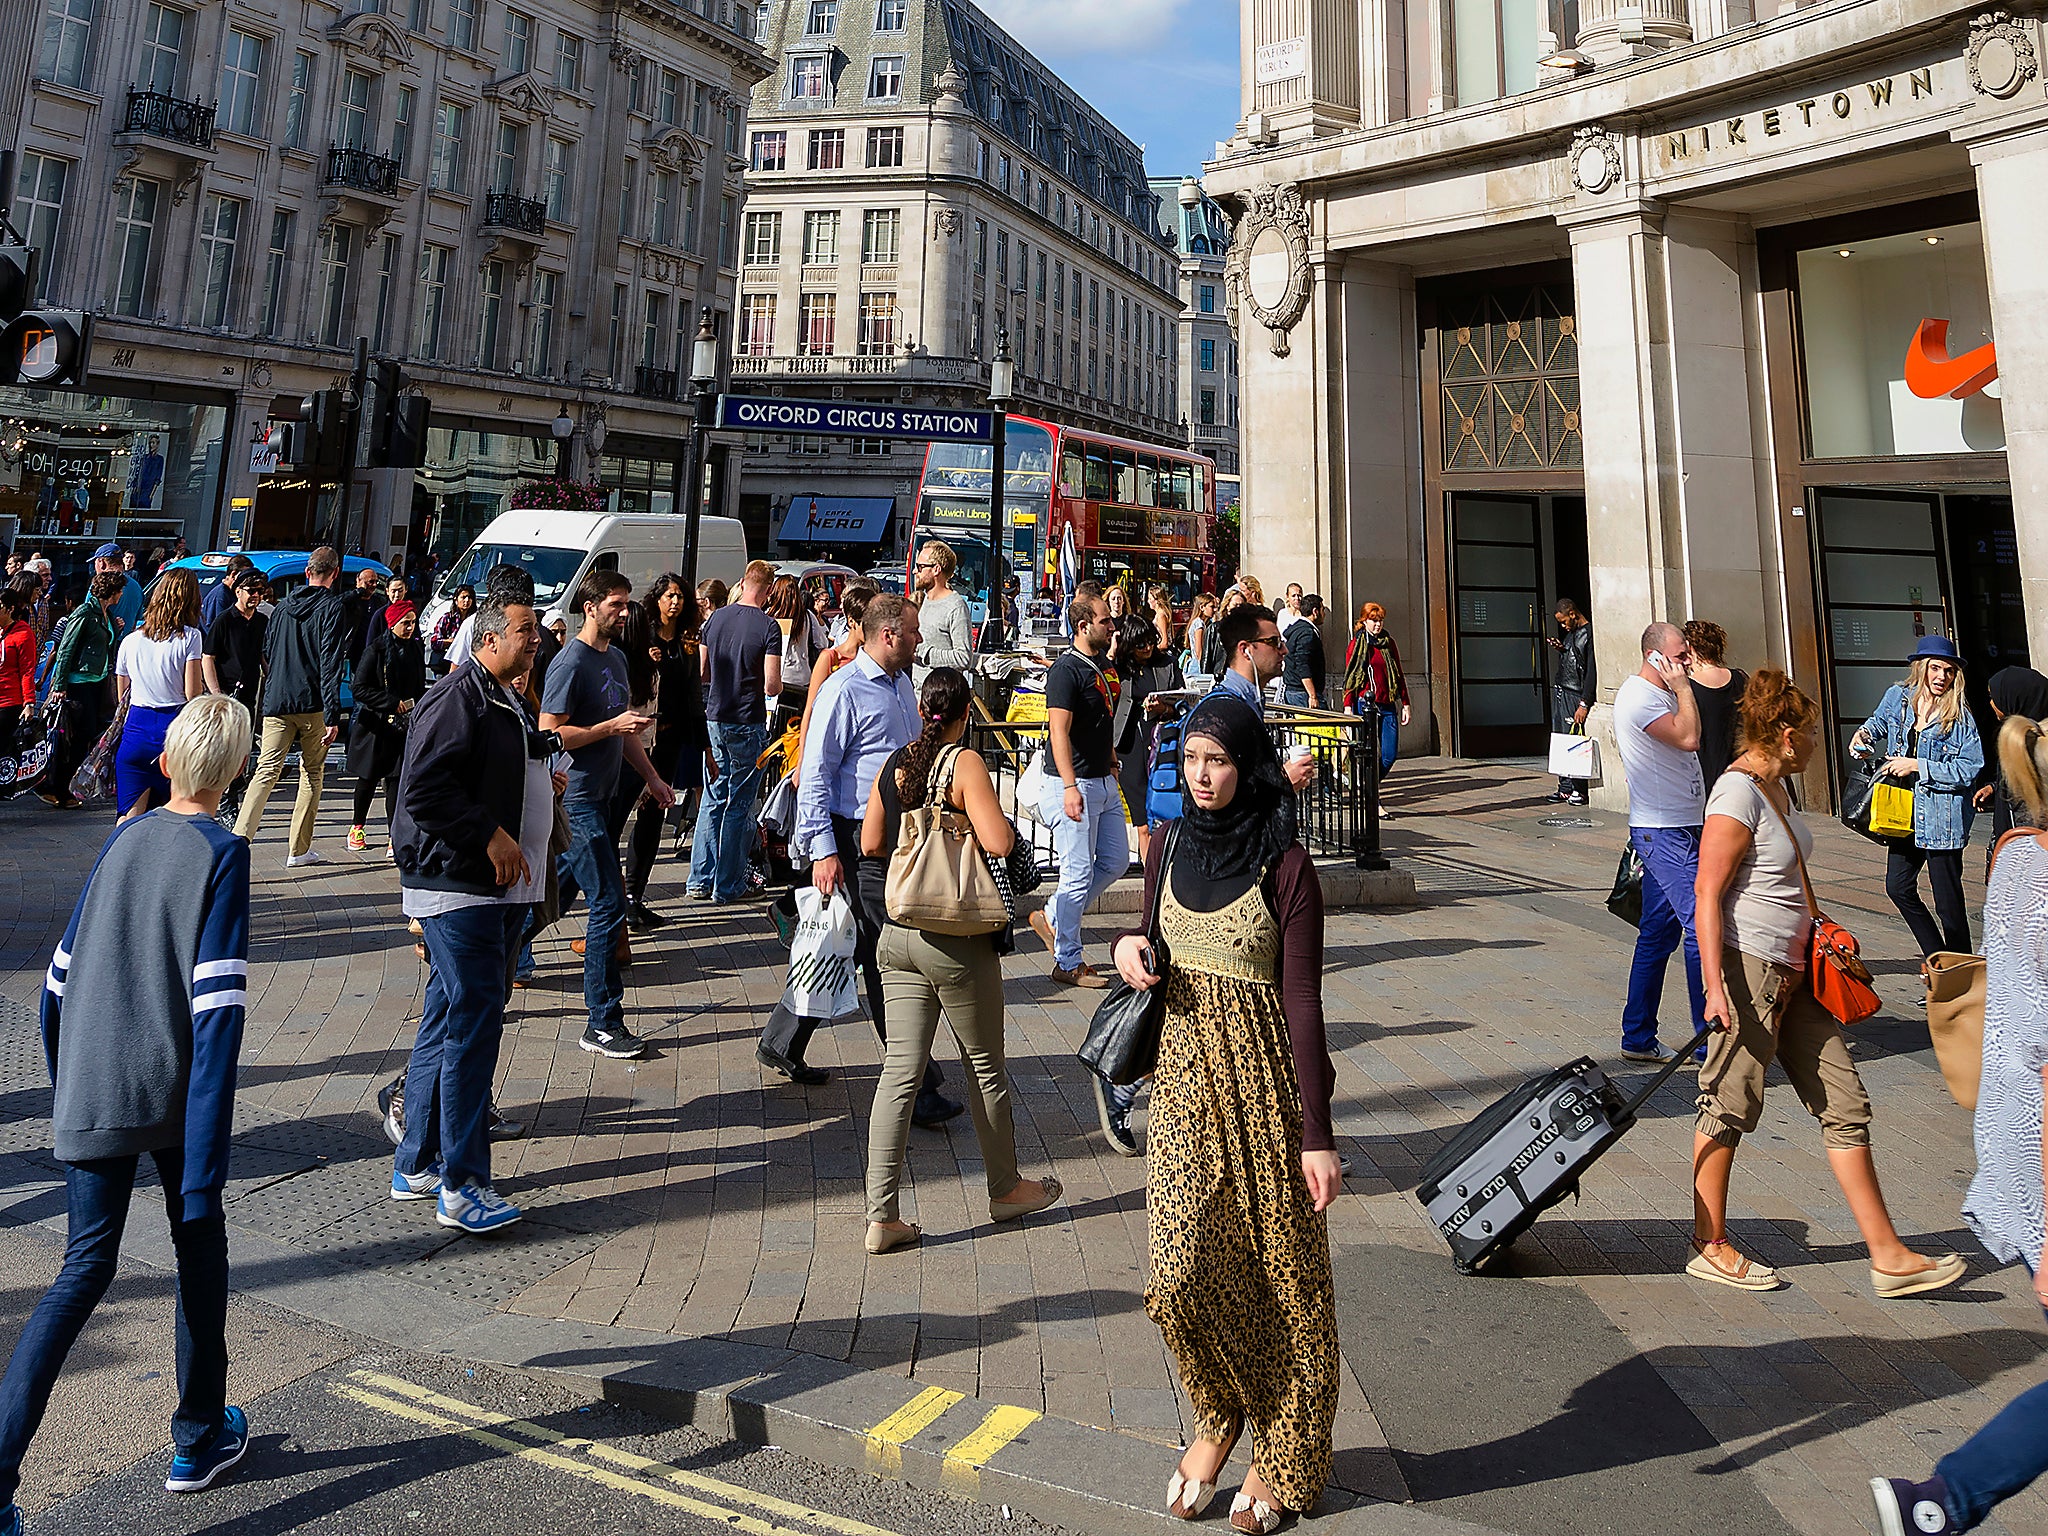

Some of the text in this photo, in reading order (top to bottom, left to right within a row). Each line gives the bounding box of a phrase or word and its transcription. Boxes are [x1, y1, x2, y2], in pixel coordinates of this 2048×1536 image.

[1260, 44, 1293, 59] OXFORD
[1260, 59, 1288, 73] CIRCUS
[1668, 68, 1933, 160] NIKETOWN
[111, 348, 136, 368] H&M
[222, 366, 235, 376] 263
[938, 367, 964, 375] HOUSE
[738, 403, 978, 434] OXFORD CIRCUS STATION
[934, 506, 965, 518] Dulwich
[967, 508, 991, 522] Library
[806, 518, 865, 528] NERO
